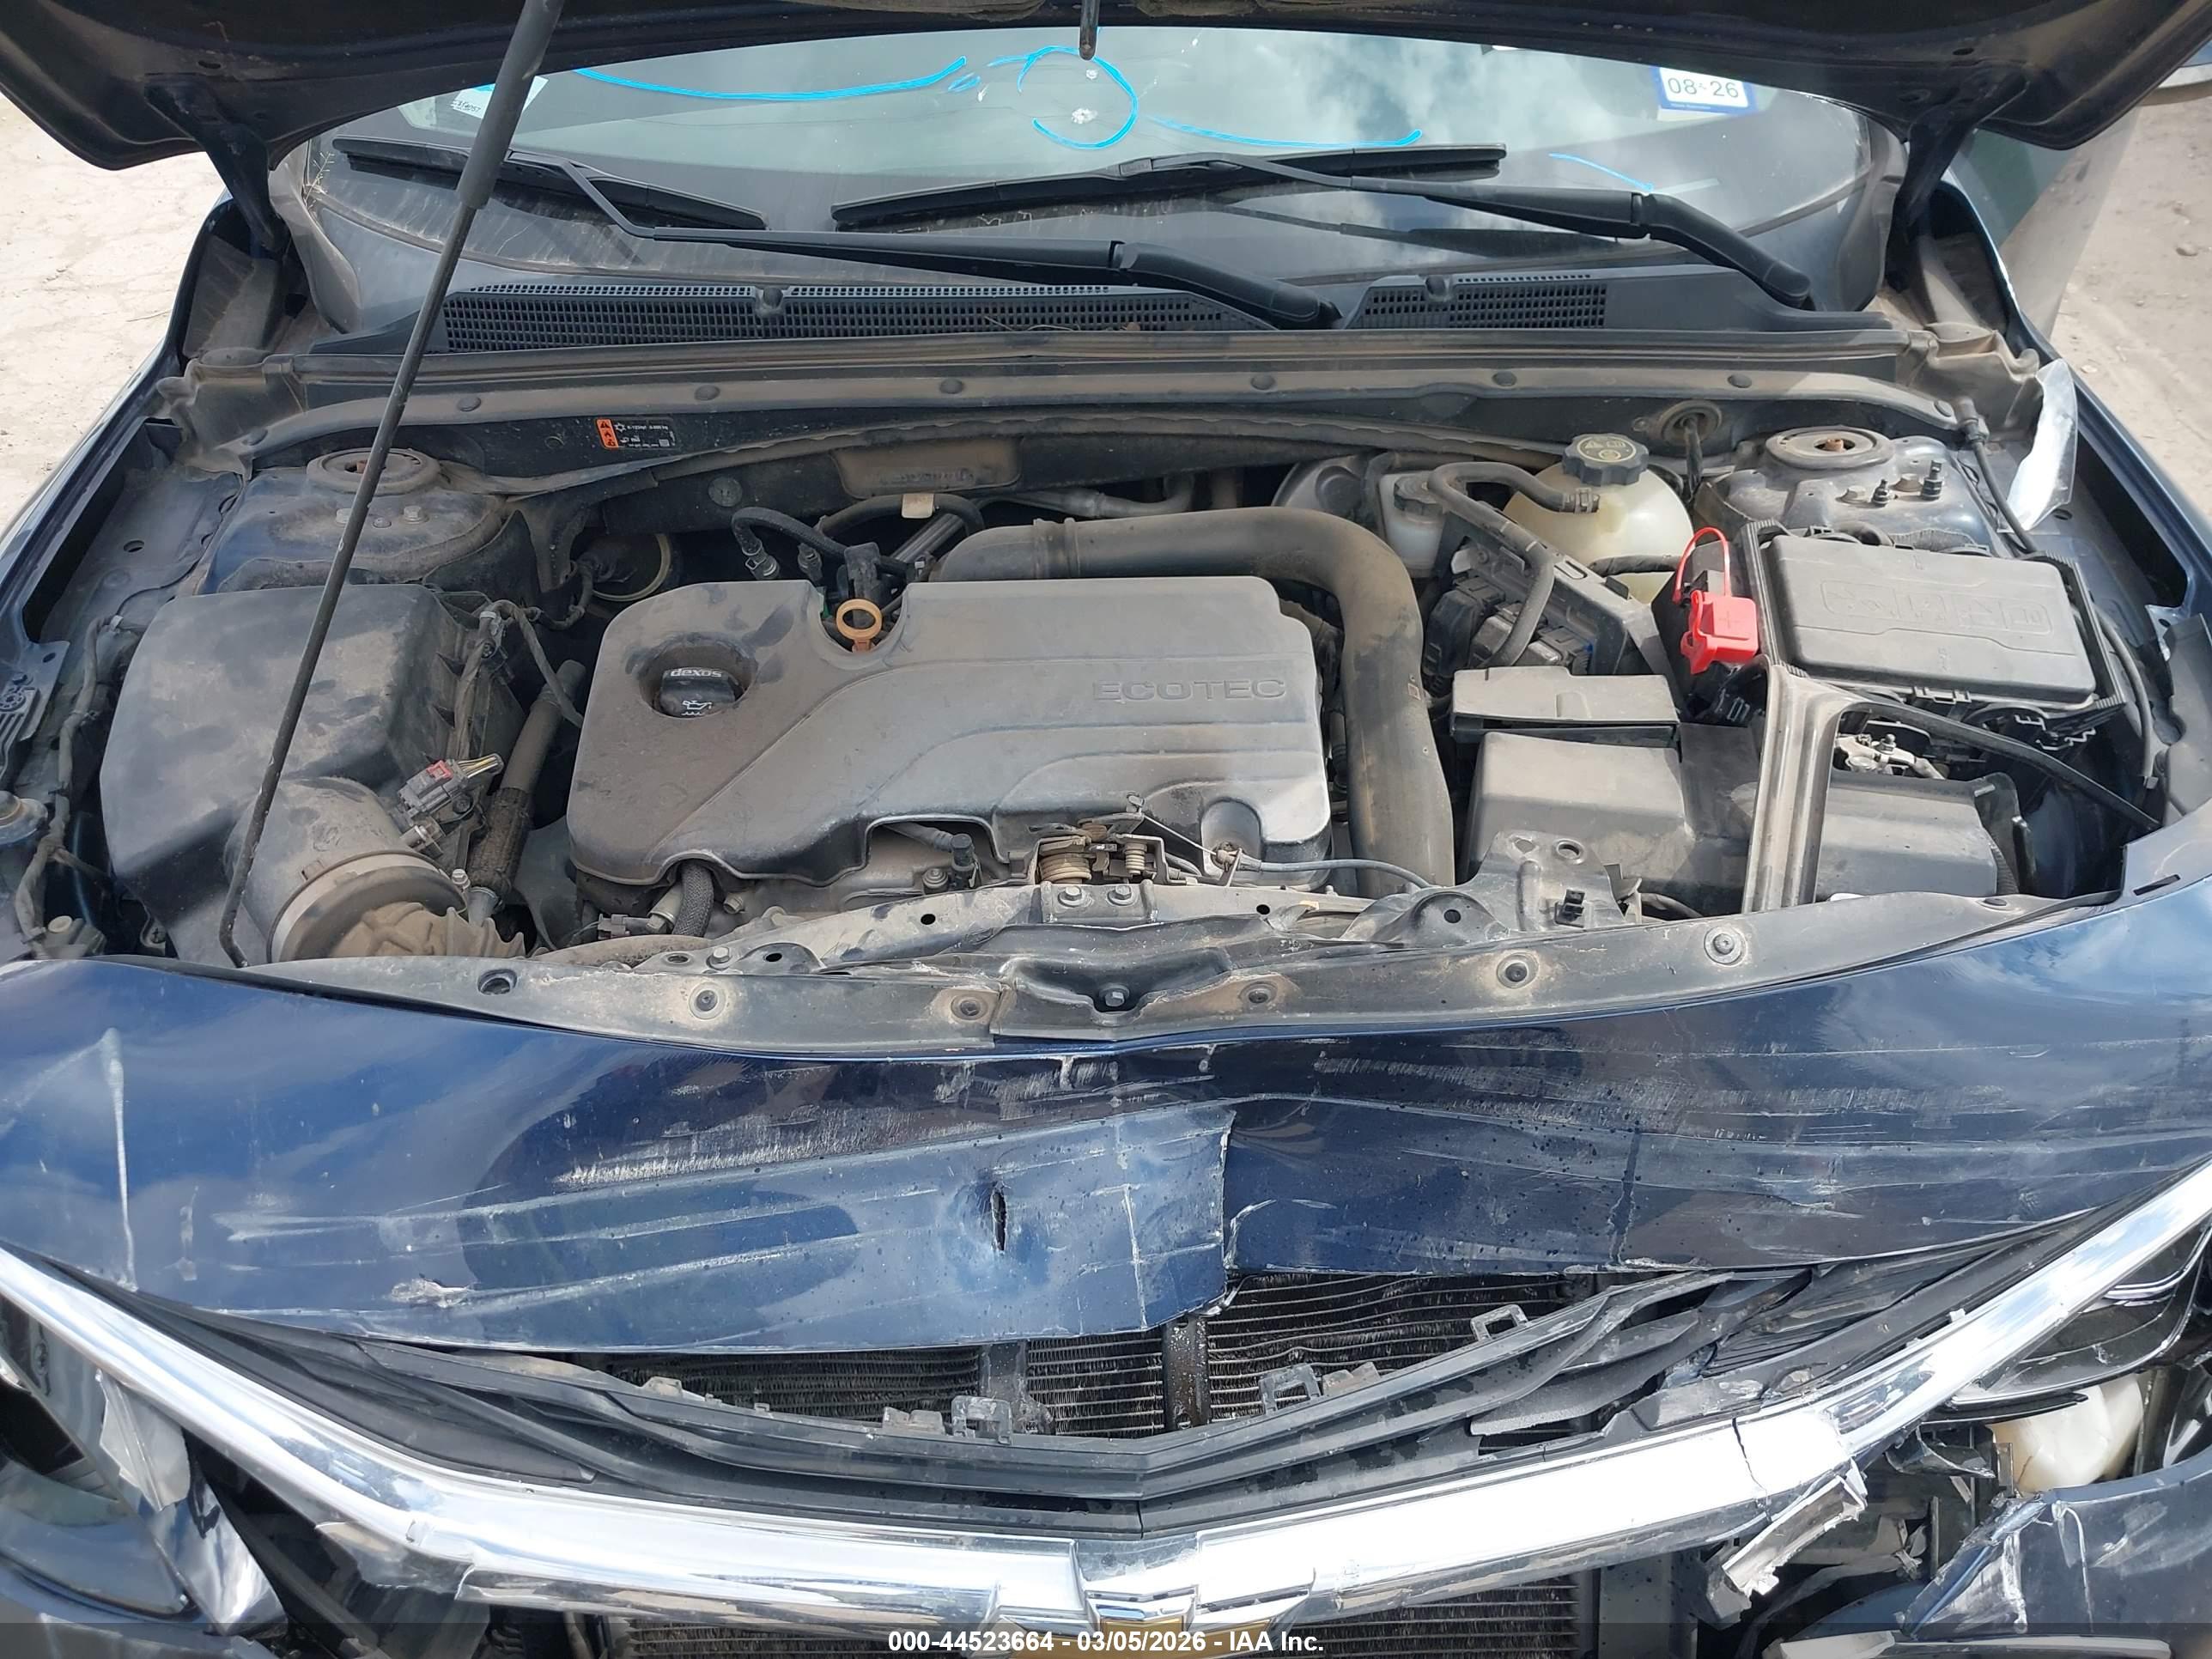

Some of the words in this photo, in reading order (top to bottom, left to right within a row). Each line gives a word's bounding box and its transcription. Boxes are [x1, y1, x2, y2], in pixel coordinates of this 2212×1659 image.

[1667, 77, 1698, 95] 08
[1710, 81, 1740, 99] 26
[670, 668, 722, 678] dexos
[1093, 678, 1286, 702] ECOTEC
